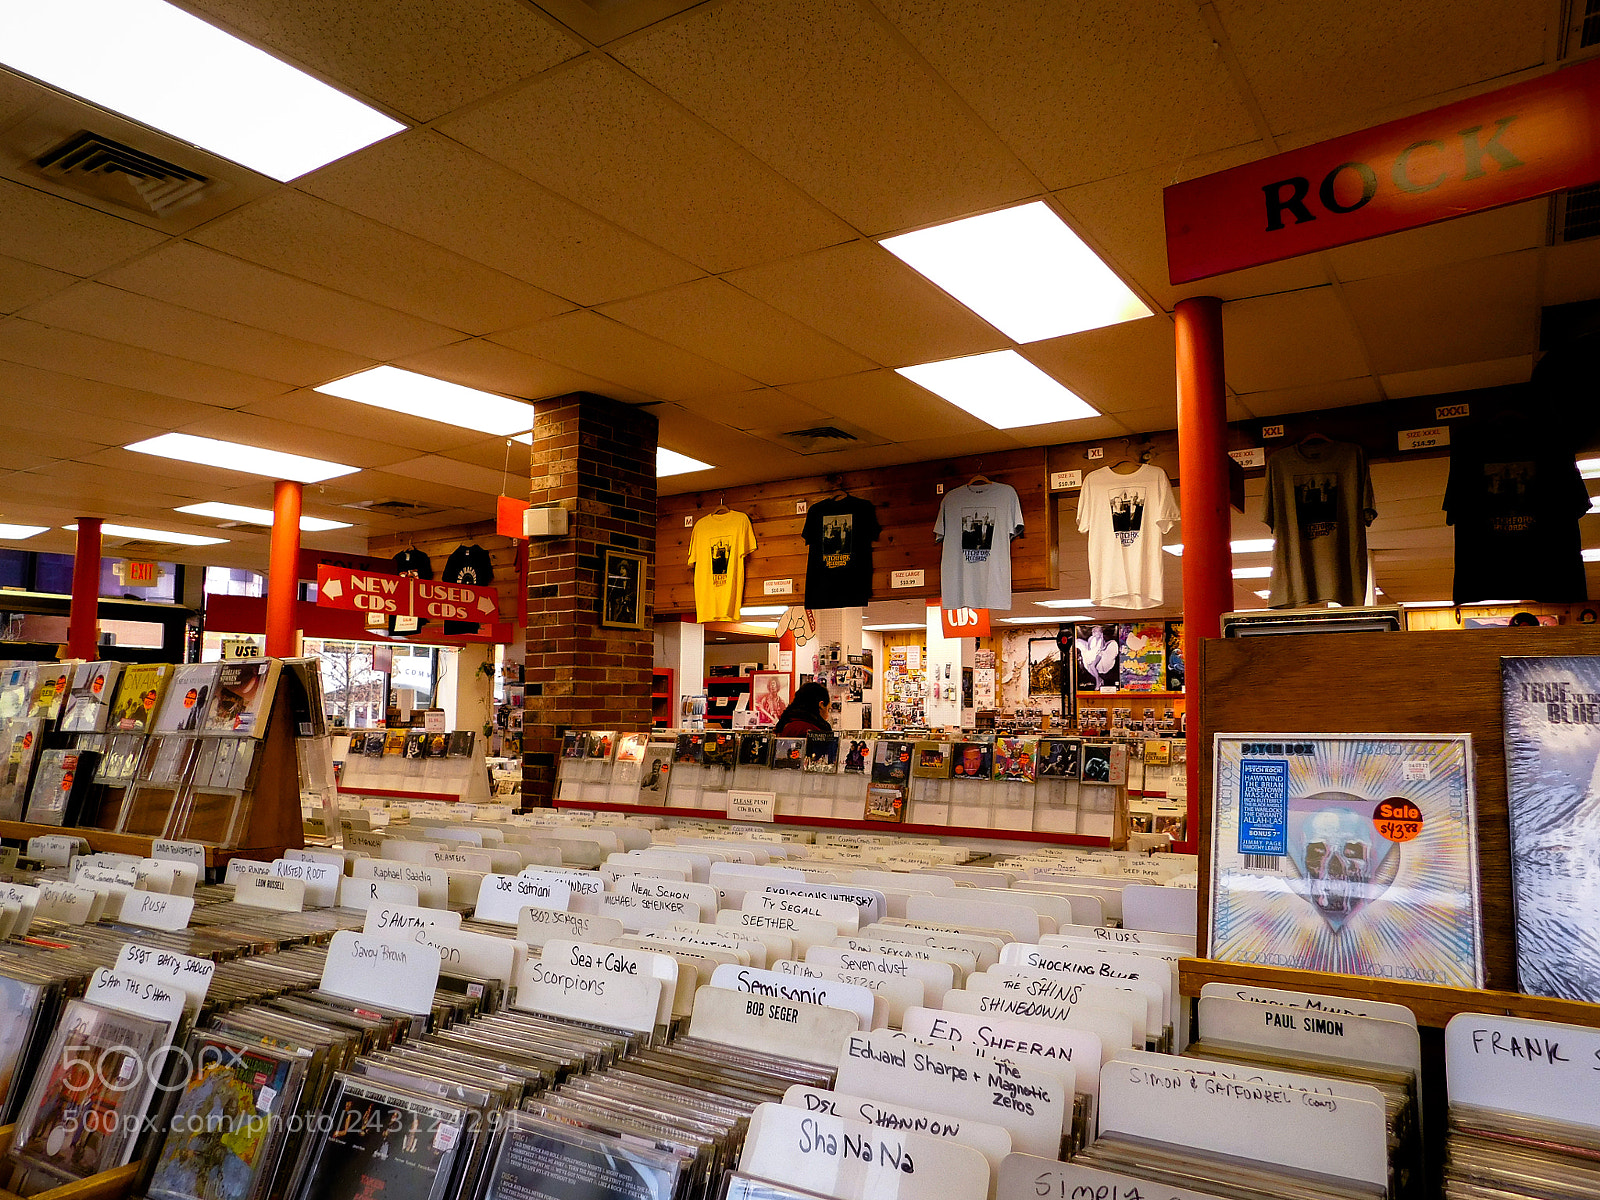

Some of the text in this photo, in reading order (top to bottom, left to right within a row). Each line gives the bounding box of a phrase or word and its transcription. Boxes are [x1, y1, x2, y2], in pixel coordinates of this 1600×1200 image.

[1262, 116, 1525, 232] ROCK
[1437, 405, 1468, 418] XXXL
[1263, 426, 1283, 436] XXL
[798, 505, 805, 513] M
[131, 562, 154, 581] EXIT
[351, 574, 399, 595] NEW
[419, 583, 475, 603] USED
[235, 645, 259, 657] USE
[1380, 804, 1419, 819] Sale
[373, 866, 403, 881] Raphael
[255, 879, 285, 890] LEON RUSSELL
[370, 884, 378, 899] R
[496, 877, 512, 892] Joe
[631, 882, 690, 900] NEAL SCHON
[141, 895, 167, 913] RUSH
[779, 901, 822, 916] SEGALL
[741, 914, 799, 932] SEETHER
[570, 945, 592, 968] Sea
[604, 952, 638, 975] Cake
[1027, 952, 1096, 975] SHOCKING
[532, 963, 606, 996] Scorpions
[1026, 978, 1083, 1005] SHINS
[746, 1000, 800, 1024] BOB SEGER
[980, 996, 1071, 1021] SHINEDOWN
[929, 1018, 963, 1043] ED
[1265, 1011, 1344, 1037] PAUL SIMON
[1472, 1029, 1570, 1065] FRANK
[848, 1036, 906, 1069] Edward
[913, 1053, 968, 1083] Sharpe
[995, 1060, 1021, 1080] The
[987, 1073, 1051, 1103] Magnetic
[859, 1103, 960, 1138] SHANNON
